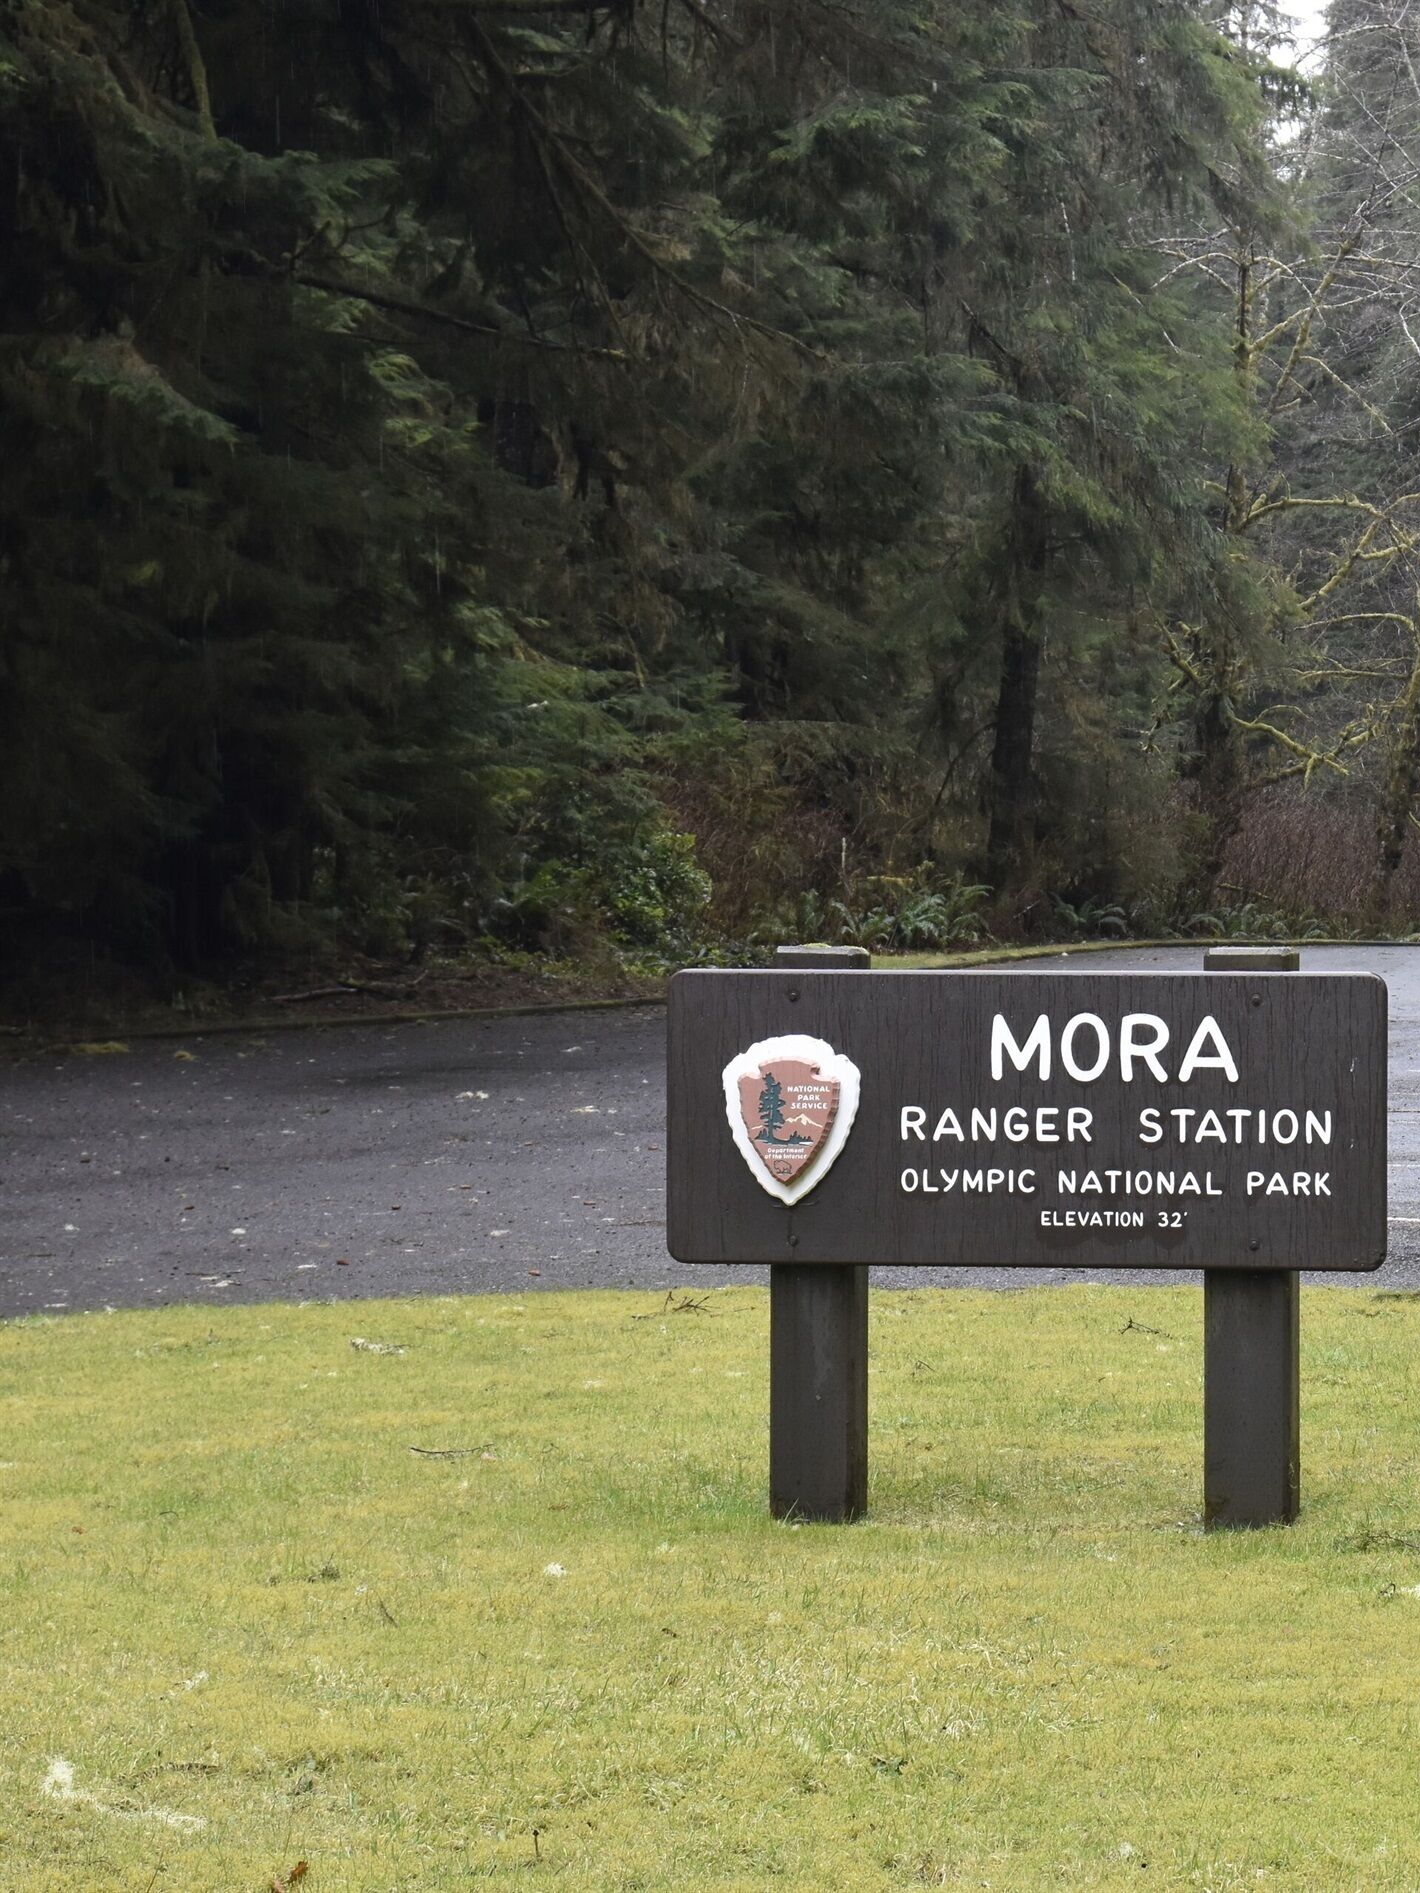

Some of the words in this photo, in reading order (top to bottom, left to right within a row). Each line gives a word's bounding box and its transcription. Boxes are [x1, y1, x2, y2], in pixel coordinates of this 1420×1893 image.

[990, 1012, 1239, 1083] MORA
[787, 1085, 830, 1093] NATIONAL
[900, 1105, 1093, 1142] RANGER
[1139, 1107, 1332, 1145] STATION
[900, 1168, 1036, 1194] OLYMPIC
[1058, 1169, 1223, 1196] NATIONAL
[1246, 1171, 1332, 1196] PARK
[1040, 1210, 1144, 1227] ELEVATION
[1158, 1210, 1188, 1228] 32'
